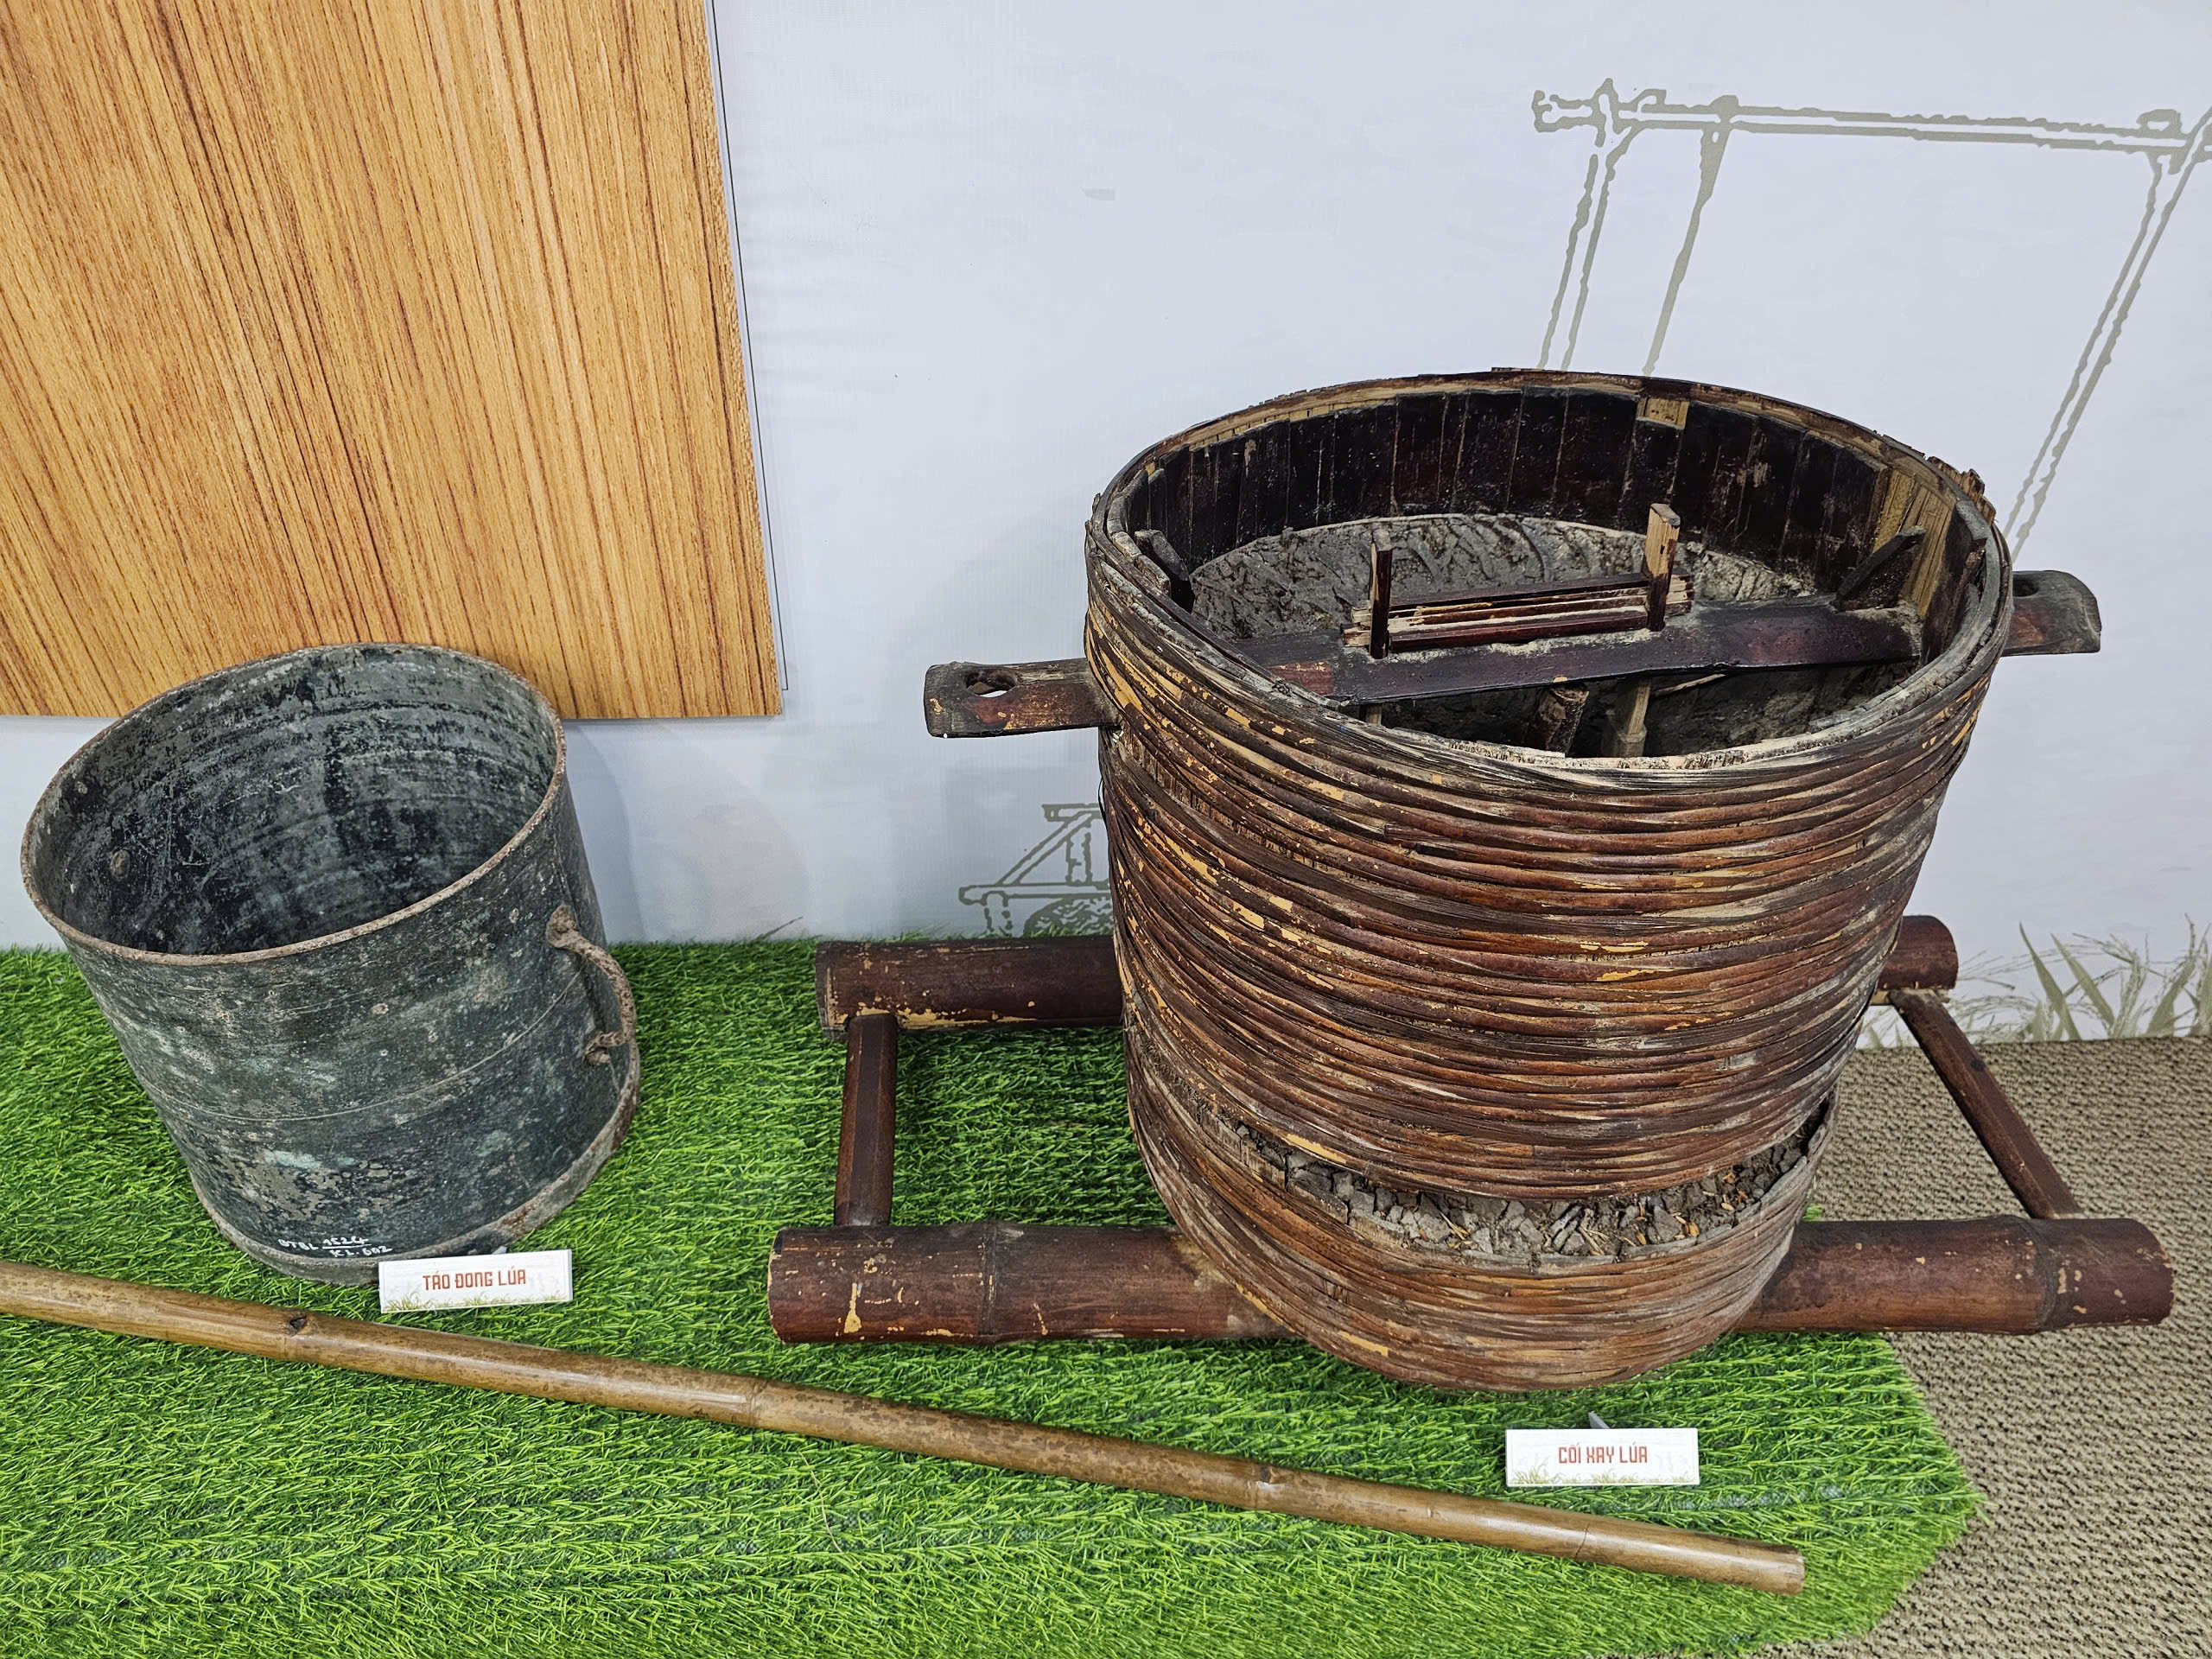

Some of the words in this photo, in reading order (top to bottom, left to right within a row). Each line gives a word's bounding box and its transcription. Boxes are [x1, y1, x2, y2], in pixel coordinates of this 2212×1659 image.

[423, 1270, 450, 1291] TÁO
[454, 1271, 493, 1288] ĐONG
[498, 1266, 526, 1286] LÚA
[1586, 1446, 1615, 1463] XAY
[1619, 1441, 1648, 1463] LÚA
